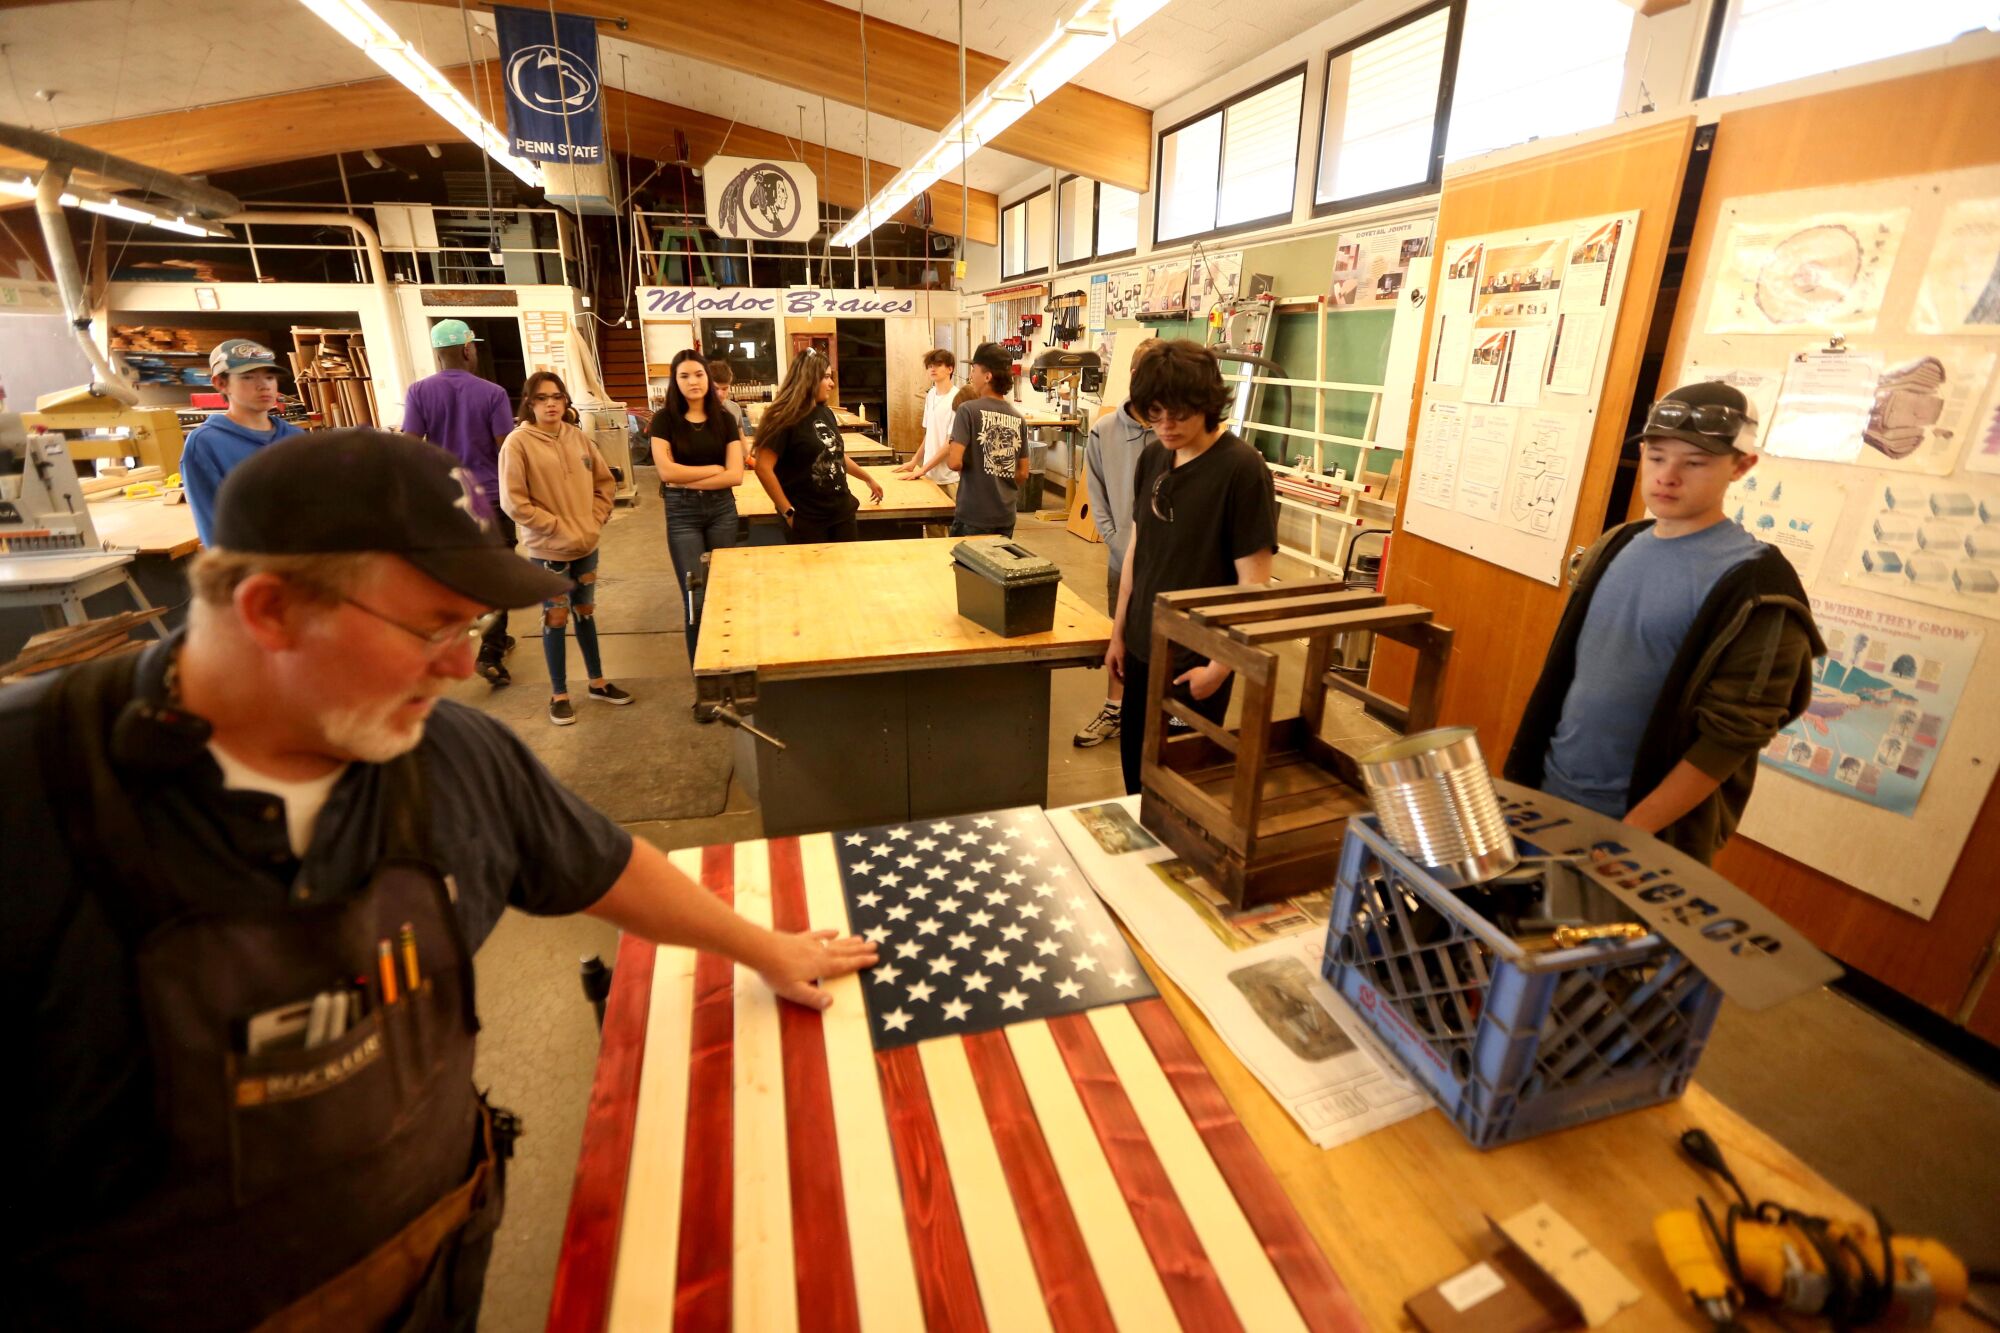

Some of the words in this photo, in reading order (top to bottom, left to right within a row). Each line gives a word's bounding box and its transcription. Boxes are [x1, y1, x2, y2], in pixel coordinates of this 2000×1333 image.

[516, 138, 555, 155] PENN
[557, 143, 599, 158] STATE
[1356, 229, 1386, 239] DOVETAIL
[1388, 223, 1412, 233] JOINTS
[646, 289, 775, 313] Modoc
[784, 290, 913, 314] Braves
[1824, 601, 1873, 621] WHERE
[1876, 611, 1917, 630] THEY
[1918, 619, 1969, 641] GROW
[1563, 840, 1782, 956] Science
